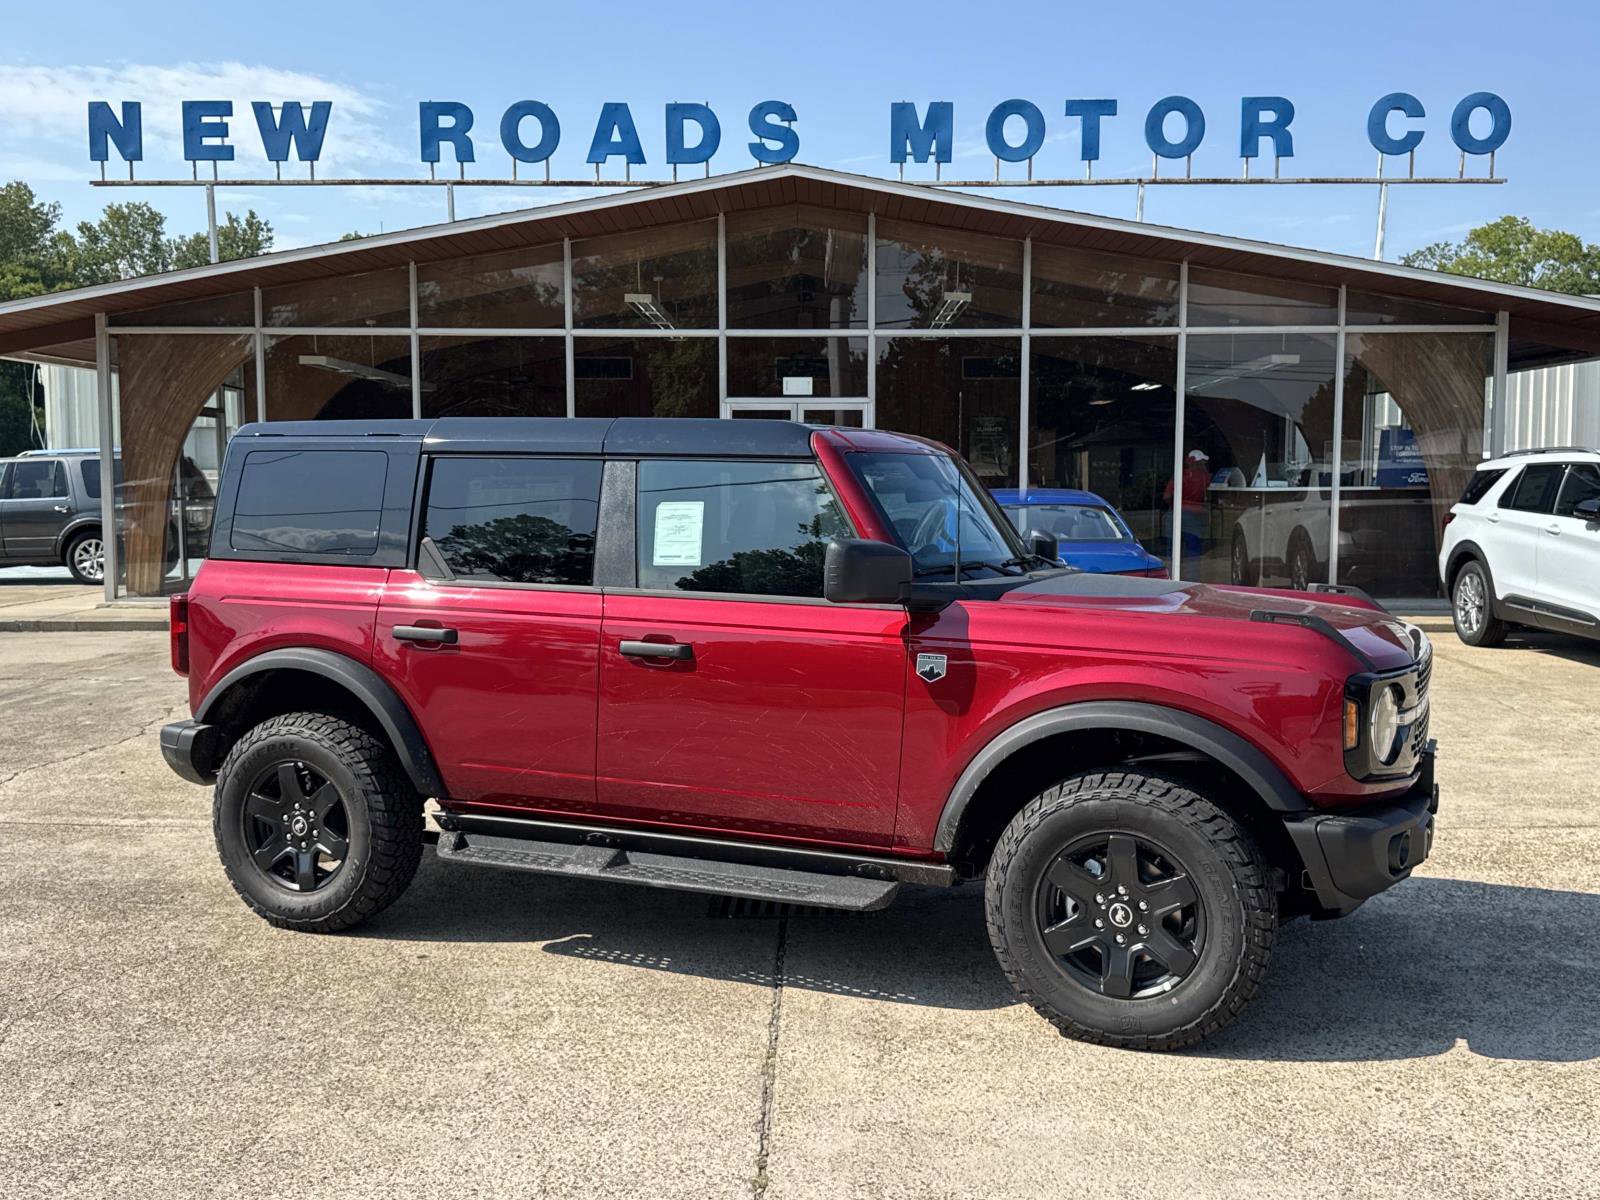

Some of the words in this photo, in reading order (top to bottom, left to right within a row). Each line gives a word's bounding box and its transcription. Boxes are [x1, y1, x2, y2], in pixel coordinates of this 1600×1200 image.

[88, 101, 332, 161] NEW
[419, 99, 800, 164] ROADS
[890, 95, 1295, 163] MOTOR
[1367, 92, 1511, 155] CO
